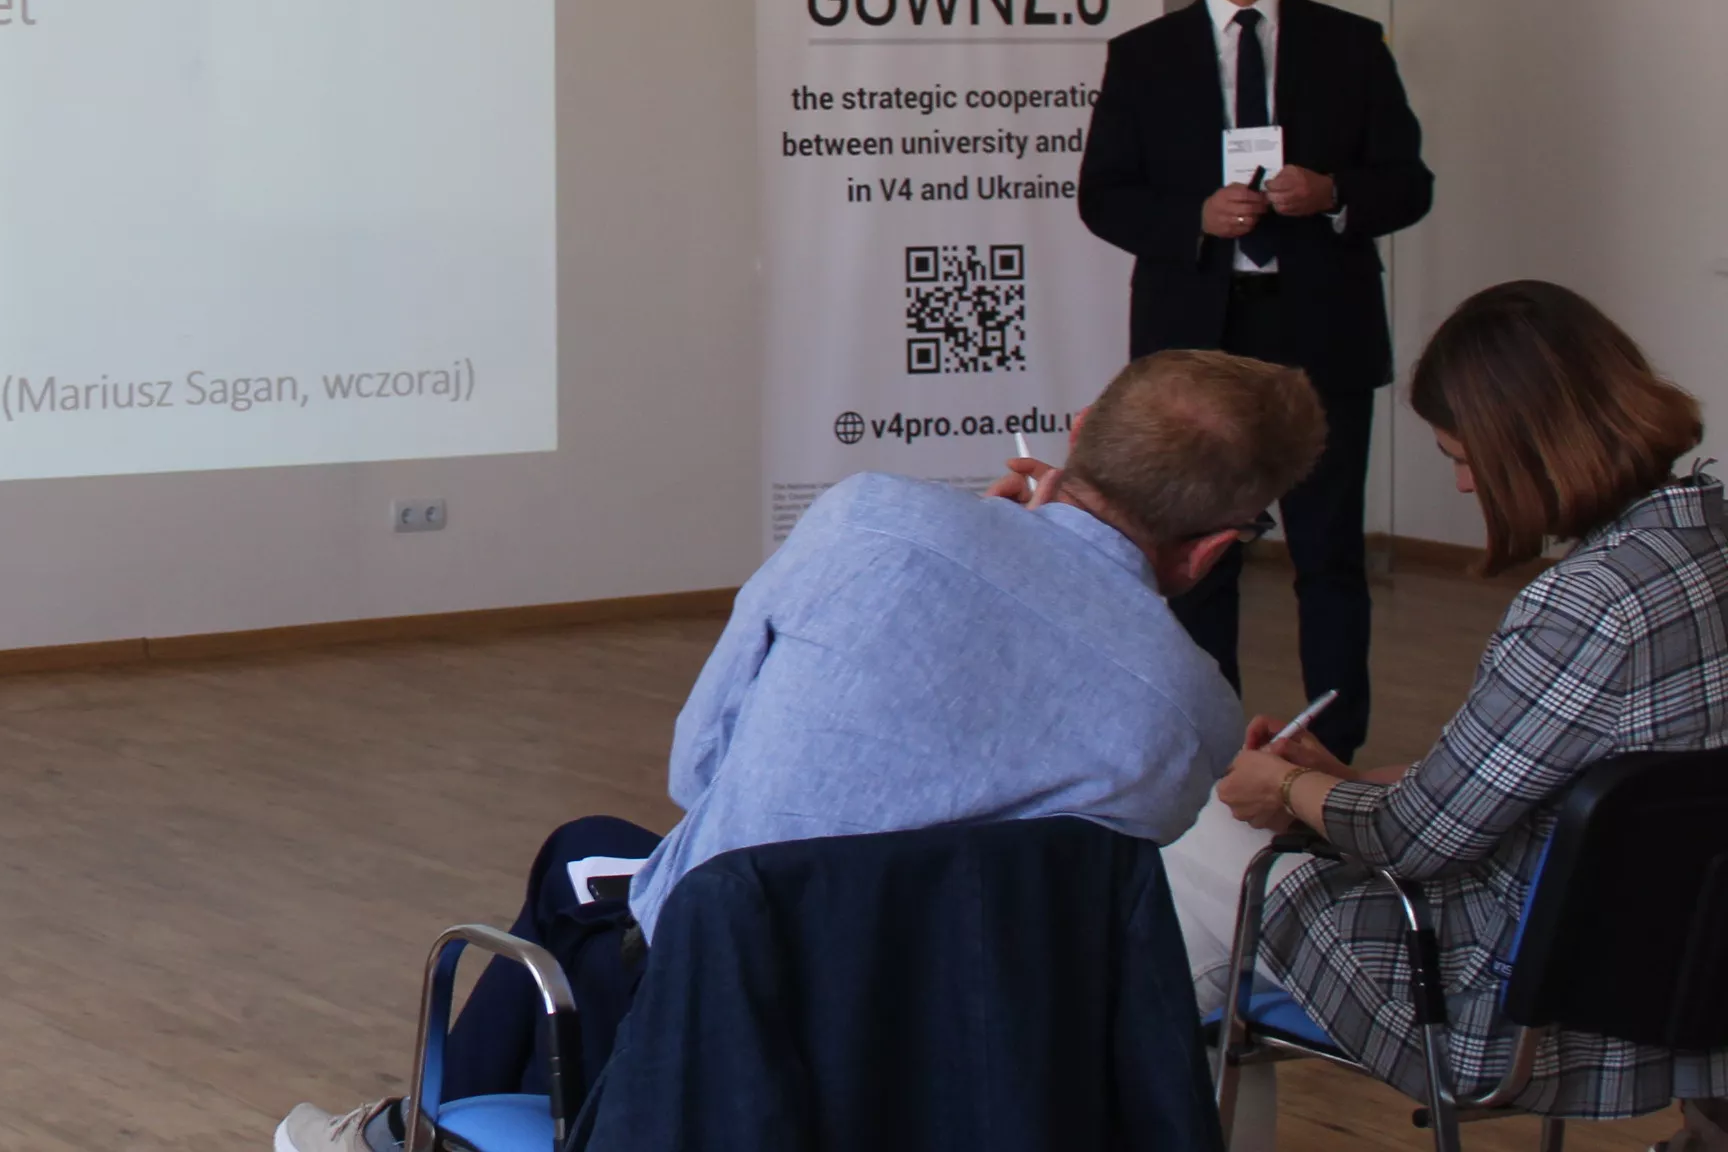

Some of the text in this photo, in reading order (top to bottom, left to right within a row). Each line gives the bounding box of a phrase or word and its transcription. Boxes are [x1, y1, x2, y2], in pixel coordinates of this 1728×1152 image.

[791, 82, 1101, 116] the strategic cooperatio
[783, 128, 1083, 159] between university and
[847, 175, 1076, 202] in V4 and Ukraine
[1, 374, 173, 422] (Mariusz
[185, 370, 309, 413] Sagan,
[322, 357, 475, 403] wczoraj)
